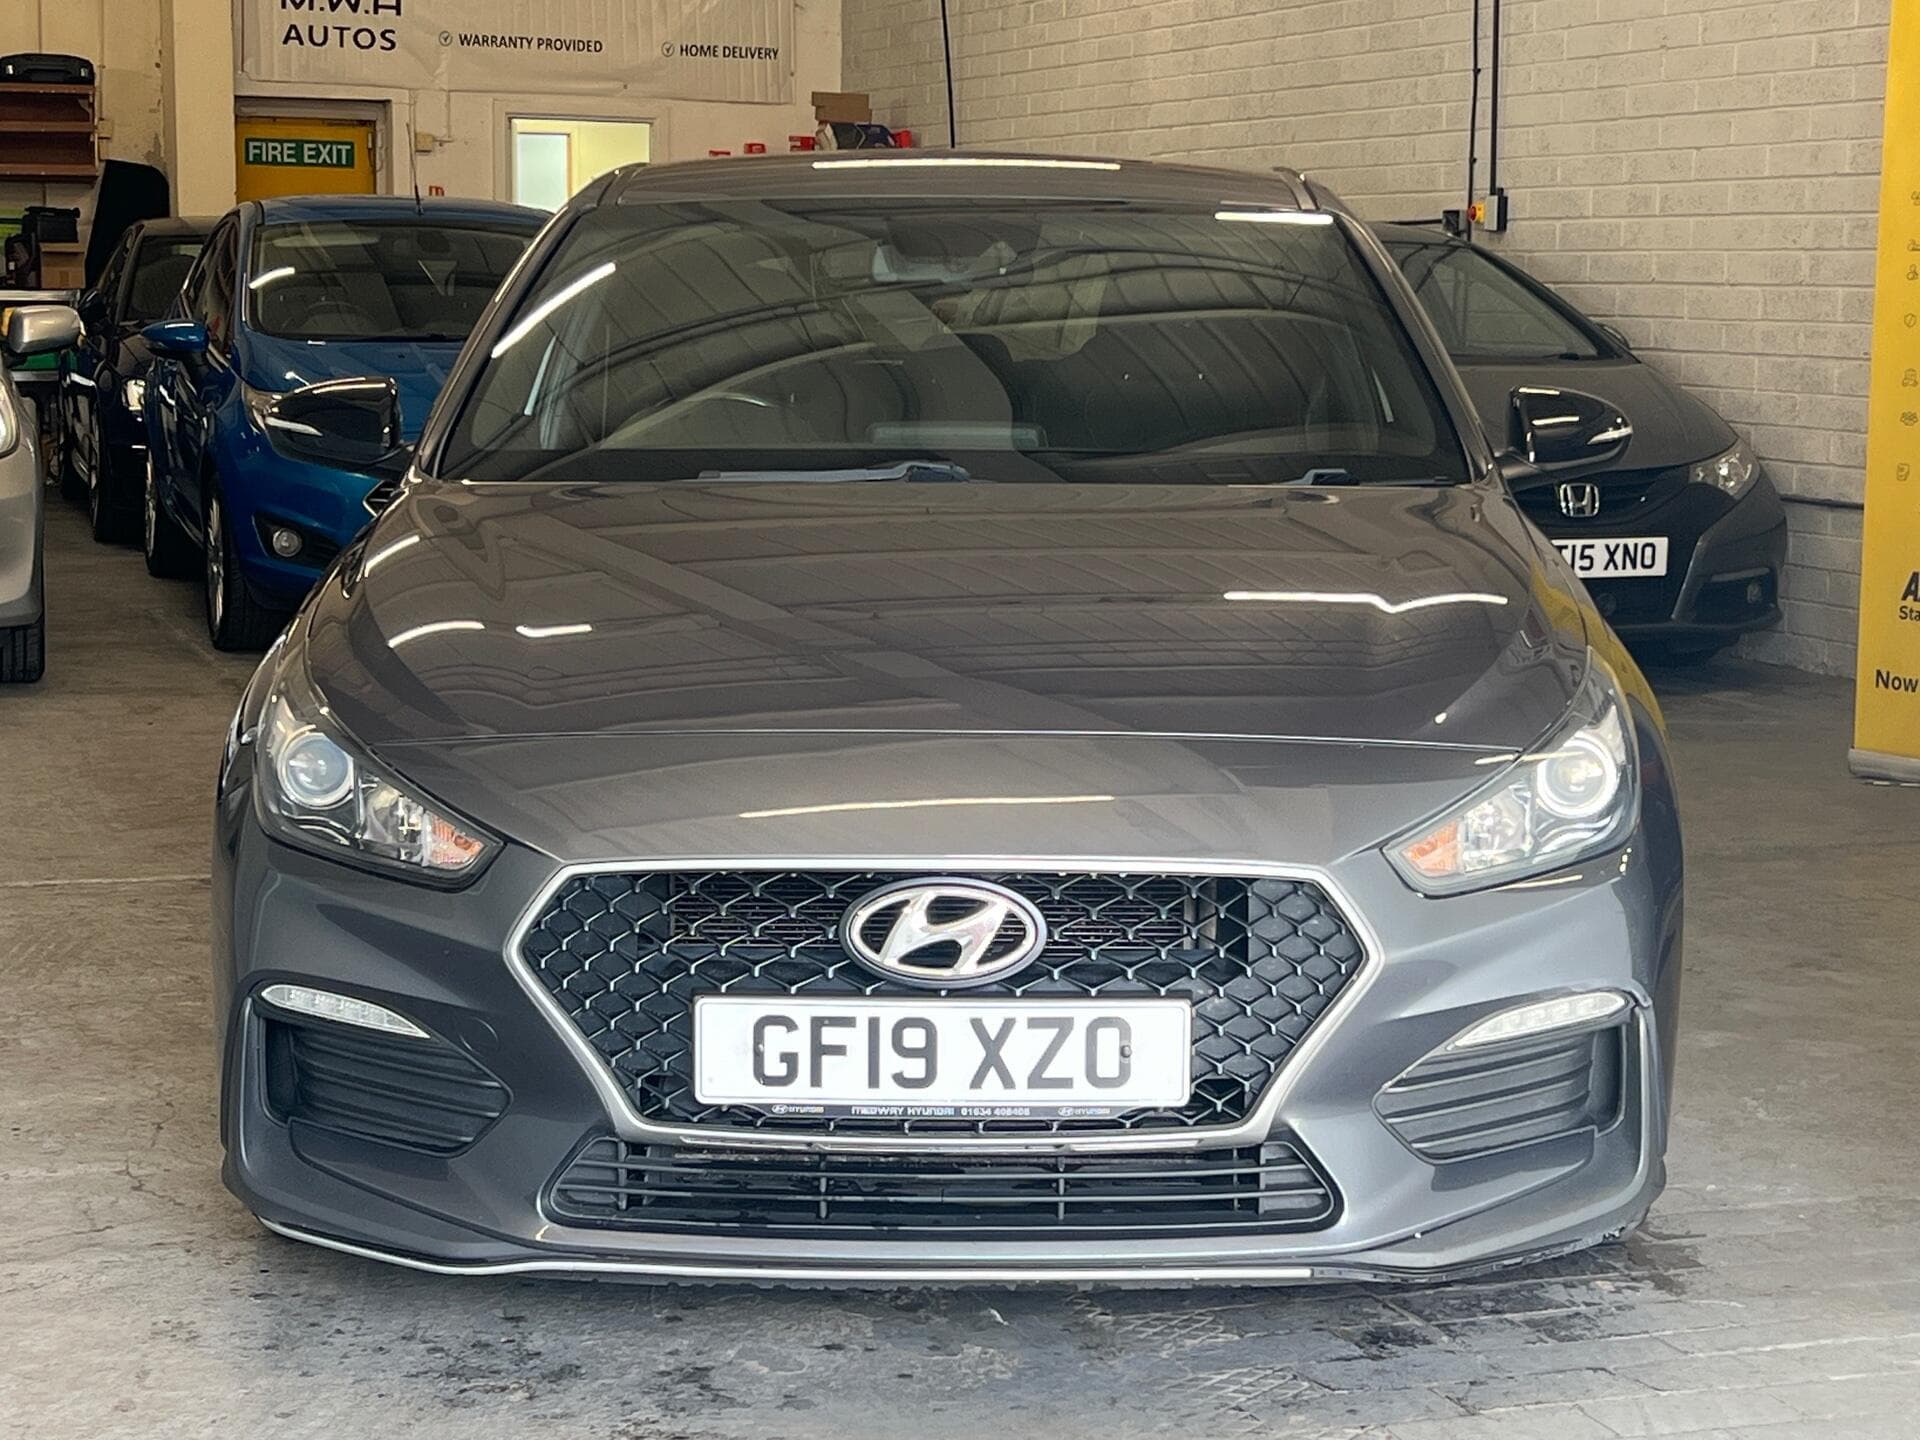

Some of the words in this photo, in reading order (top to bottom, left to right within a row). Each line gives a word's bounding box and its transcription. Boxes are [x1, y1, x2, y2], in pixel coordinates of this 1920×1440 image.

[282, 24, 397, 51] AUTOS
[459, 33, 533, 49] WARRANTY
[537, 37, 604, 53] PROVIDED
[680, 44, 719, 58] HOME
[722, 46, 779, 60] DELIVERY
[248, 141, 297, 163] FIRE
[303, 143, 352, 165] EXIT
[1603, 542, 1656, 571] XNO
[1875, 669, 1919, 693] Now
[752, 1014, 938, 1088] GF19
[851, 1105, 903, 1115] MEDWAY
[907, 1106, 955, 1116] HYUNDAI
